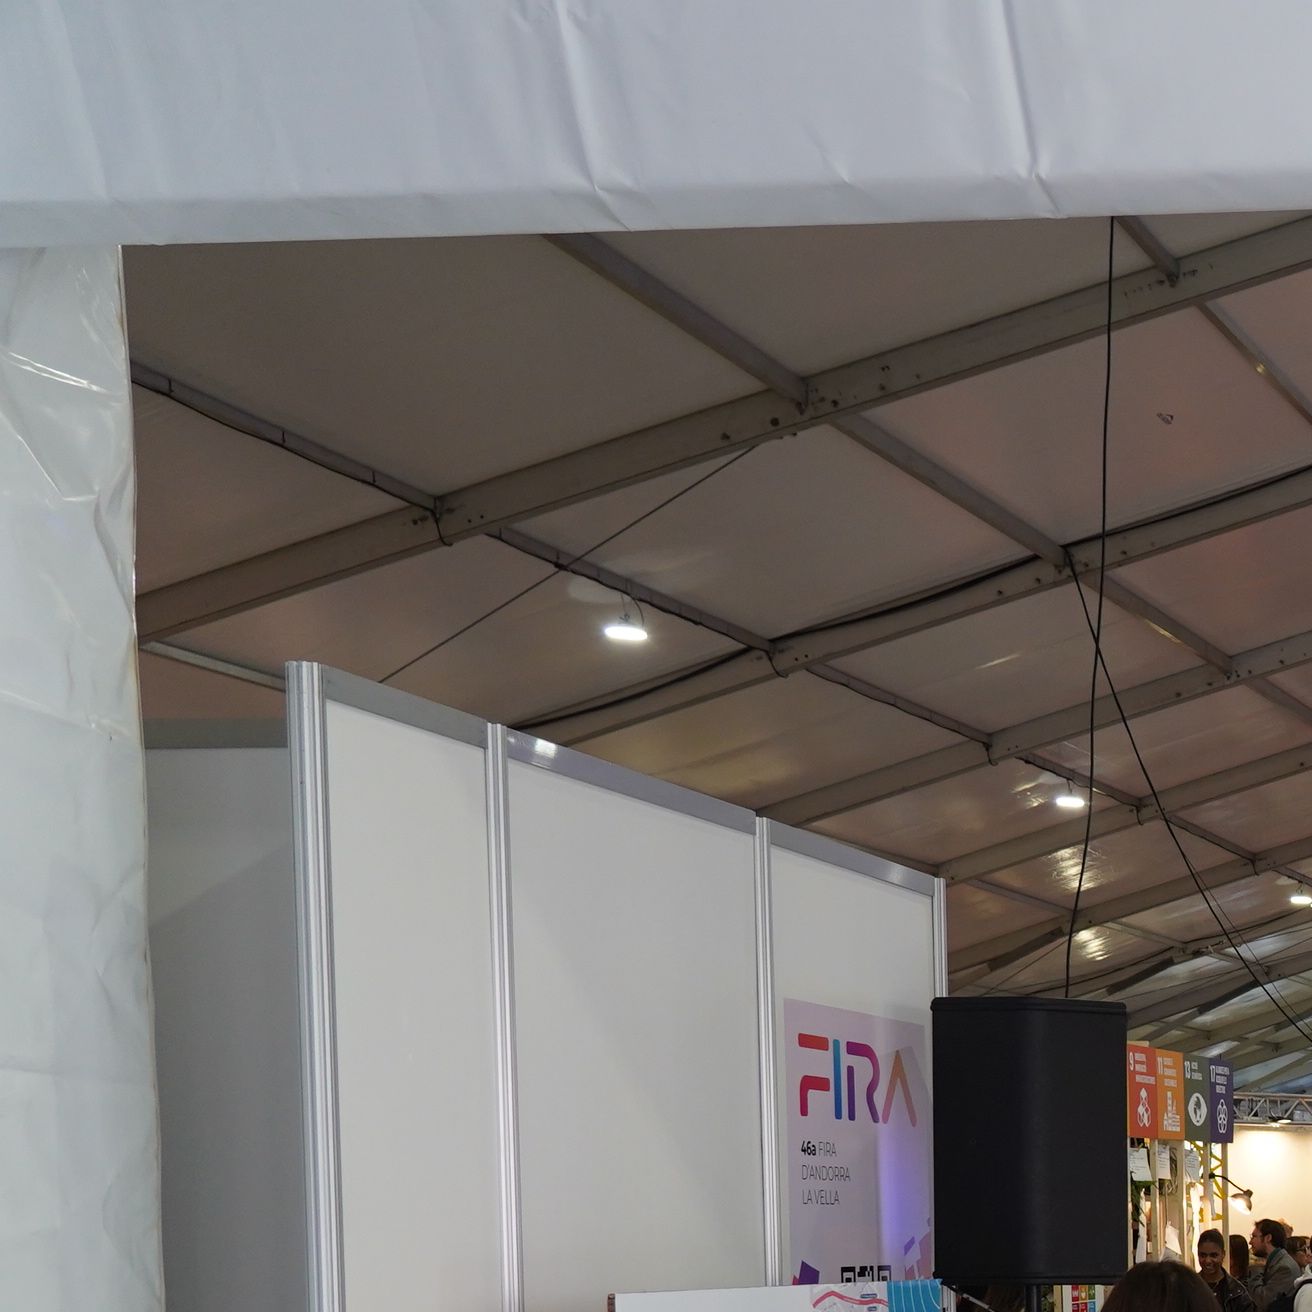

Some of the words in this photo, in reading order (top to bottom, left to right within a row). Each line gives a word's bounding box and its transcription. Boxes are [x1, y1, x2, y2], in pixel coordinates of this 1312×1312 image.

[798, 1033, 917, 1127] FIRA
[801, 1141, 816, 1157] 46a
[819, 1141, 838, 1157] FIRA
[802, 1165, 850, 1183] D'ANDORRA
[802, 1190, 812, 1205] LA
[815, 1190, 840, 1205] VELLA
